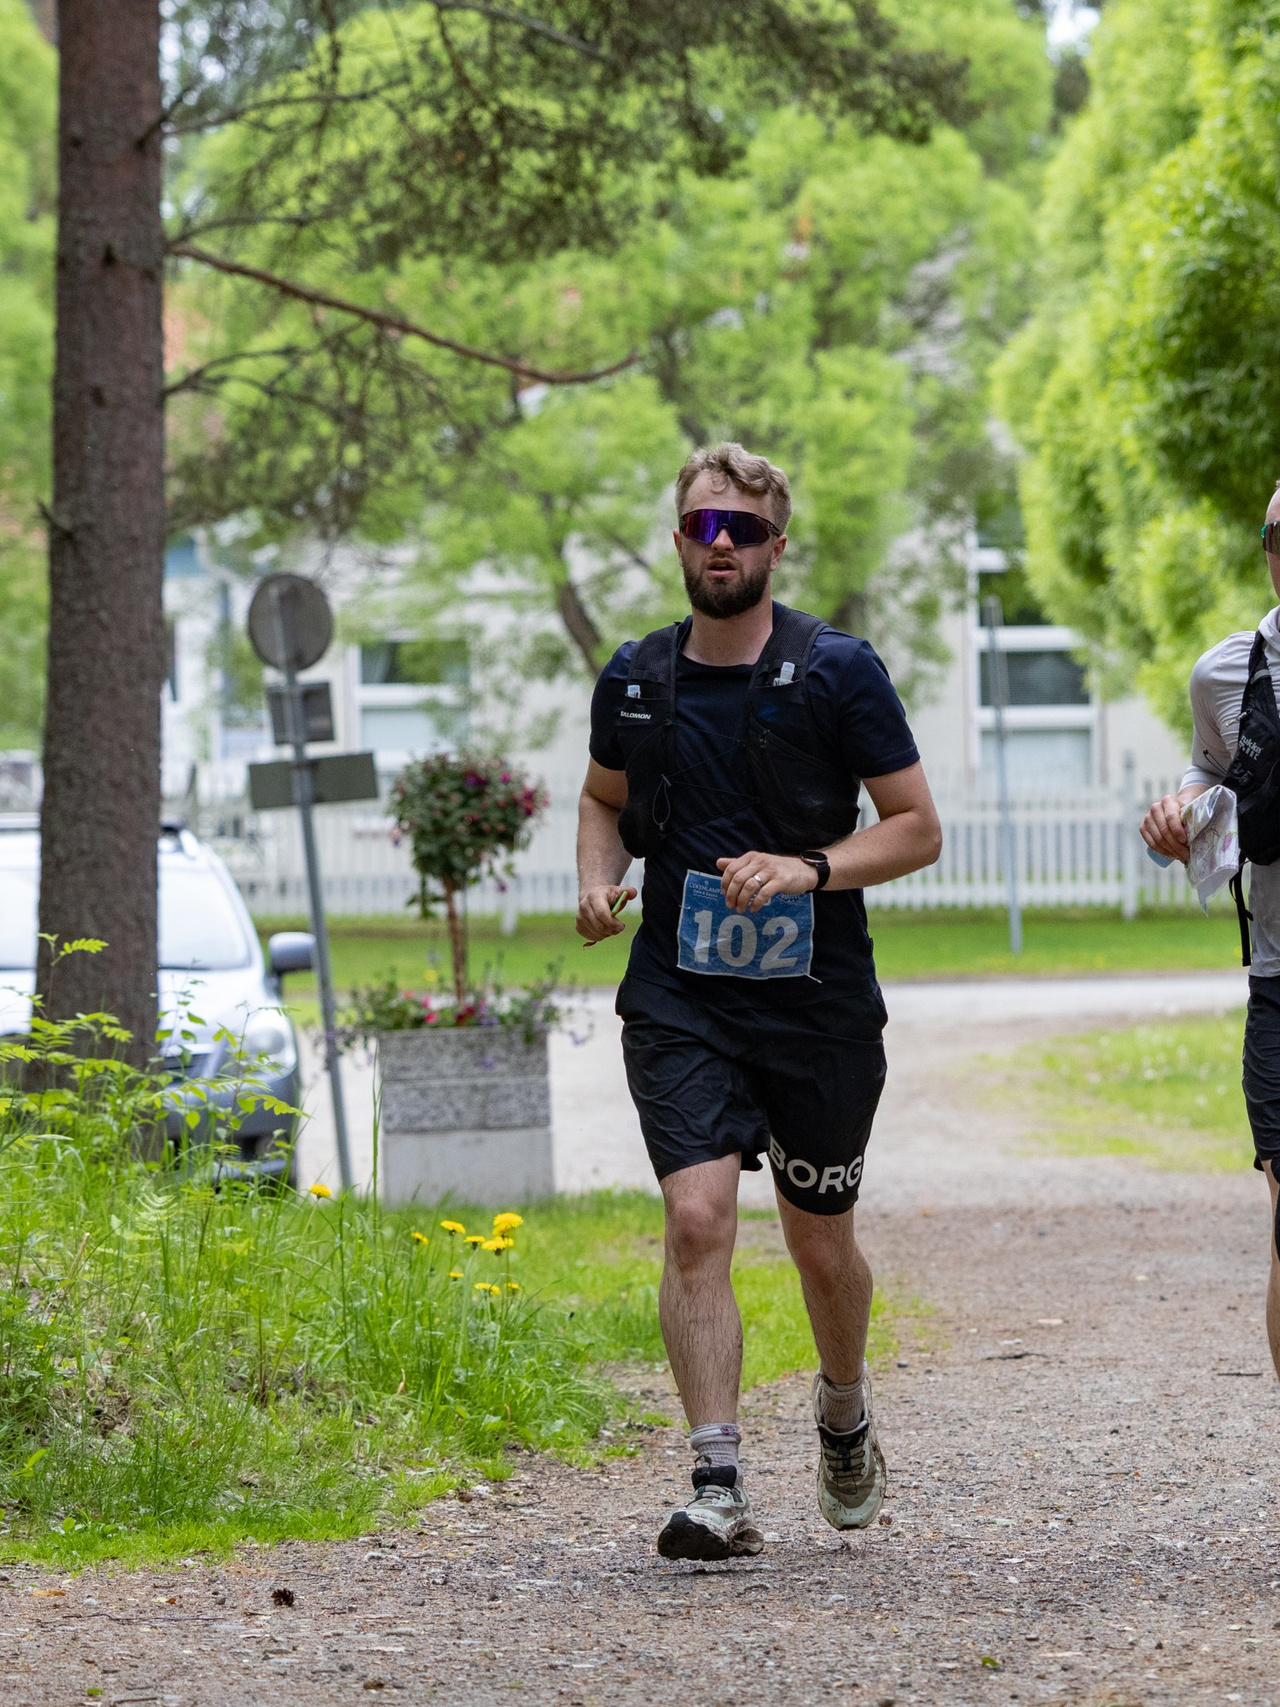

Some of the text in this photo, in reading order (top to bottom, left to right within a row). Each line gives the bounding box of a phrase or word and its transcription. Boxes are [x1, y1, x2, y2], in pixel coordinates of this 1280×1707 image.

[1240, 735, 1262, 754] rukka
[693, 909, 799, 970] 102
[768, 1134, 863, 1194] BORG
